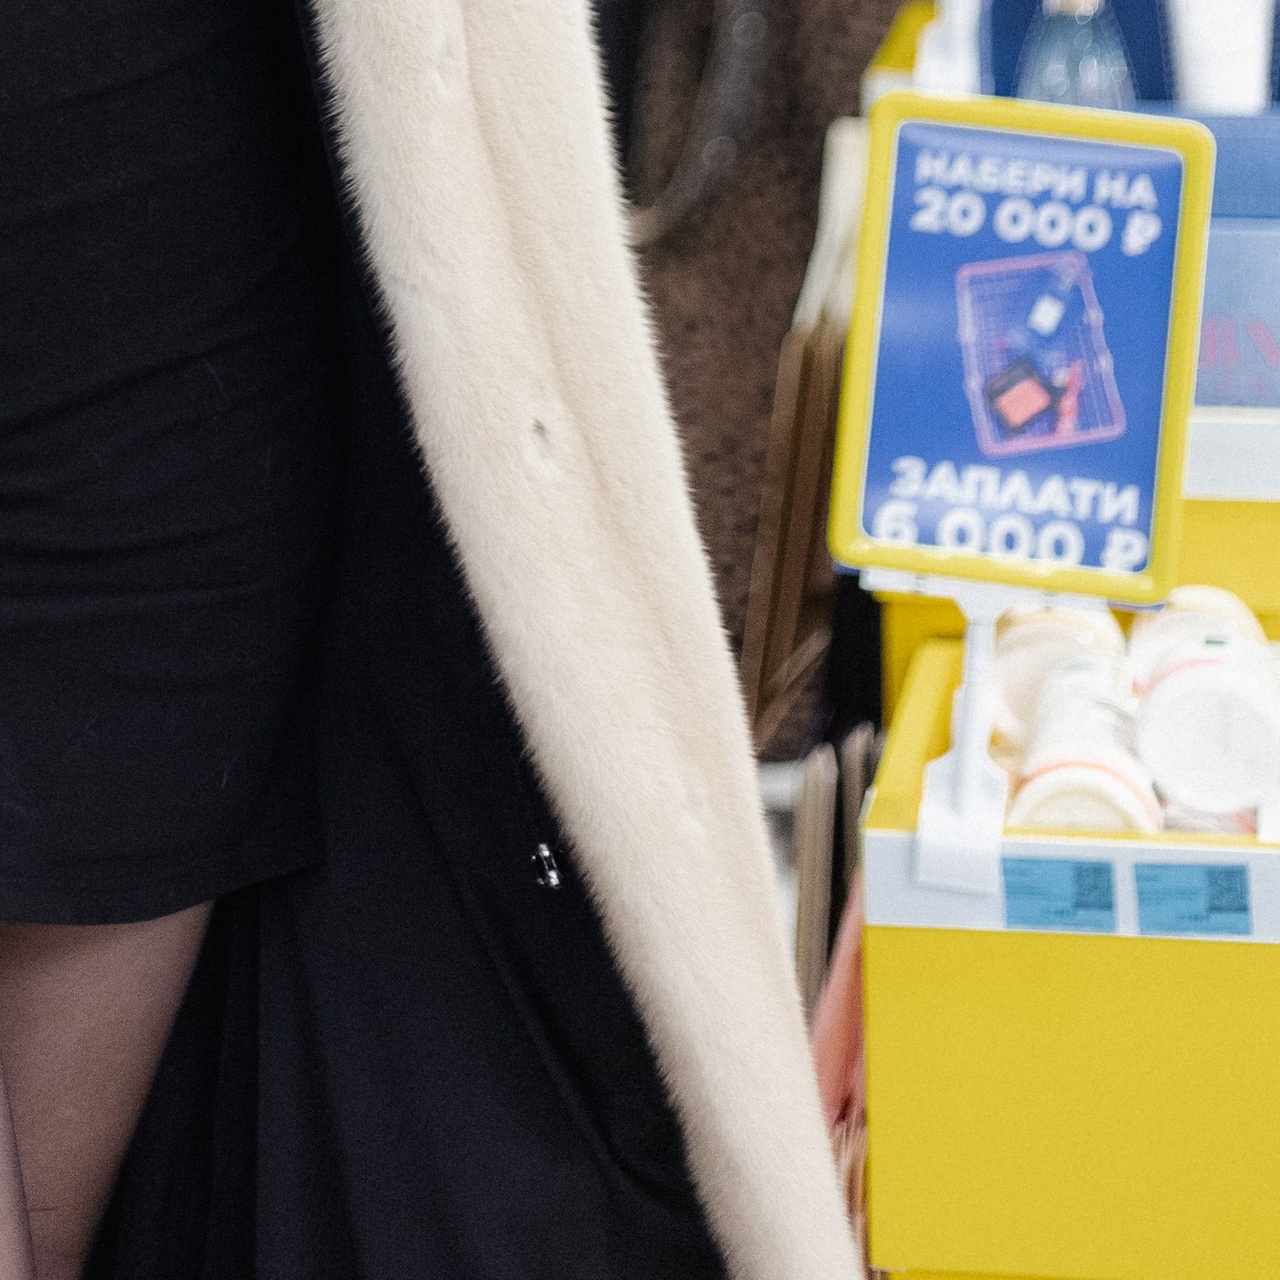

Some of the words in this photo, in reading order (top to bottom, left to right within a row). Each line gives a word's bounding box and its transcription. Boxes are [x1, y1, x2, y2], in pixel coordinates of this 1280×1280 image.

[914, 150, 1088, 204] НАБЕРИ
[1093, 168, 1158, 210] НА
[908, 188, 987, 238] 20
[992, 197, 1113, 252] 000
[889, 454, 1141, 526] ЗАПЛАТИ
[872, 500, 920, 544] 6
[935, 507, 1086, 567] 000
